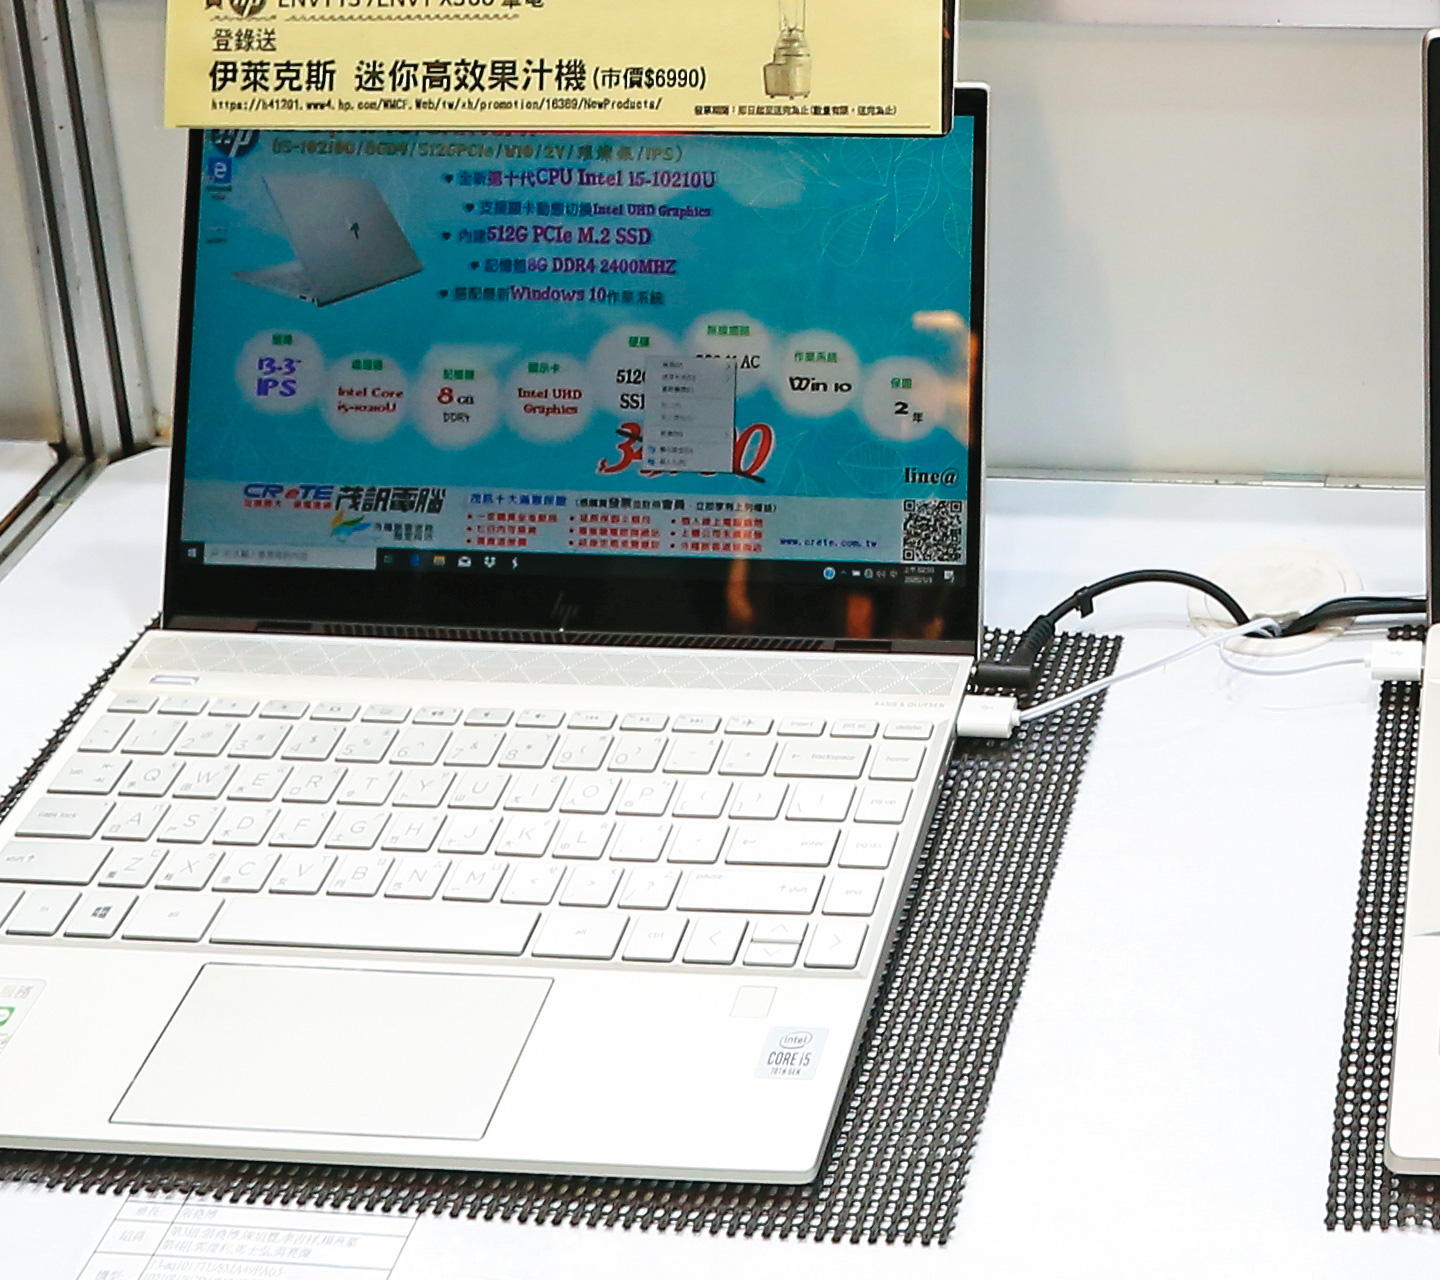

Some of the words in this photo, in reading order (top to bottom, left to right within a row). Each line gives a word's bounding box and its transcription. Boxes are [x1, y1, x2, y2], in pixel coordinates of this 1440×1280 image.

[211, 28, 277, 52] 登錄送
[208, 59, 338, 93] 伊萊克斯
[354, 58, 587, 92] 迷你高效果汁機
[591, 64, 708, 92] (市價$6990)
[577, 168, 623, 187] Intel
[577, 227, 611, 245] M.2
[615, 227, 653, 245] SSD
[788, 376, 828, 393] Win
[766, 1049, 797, 1069] CORE
